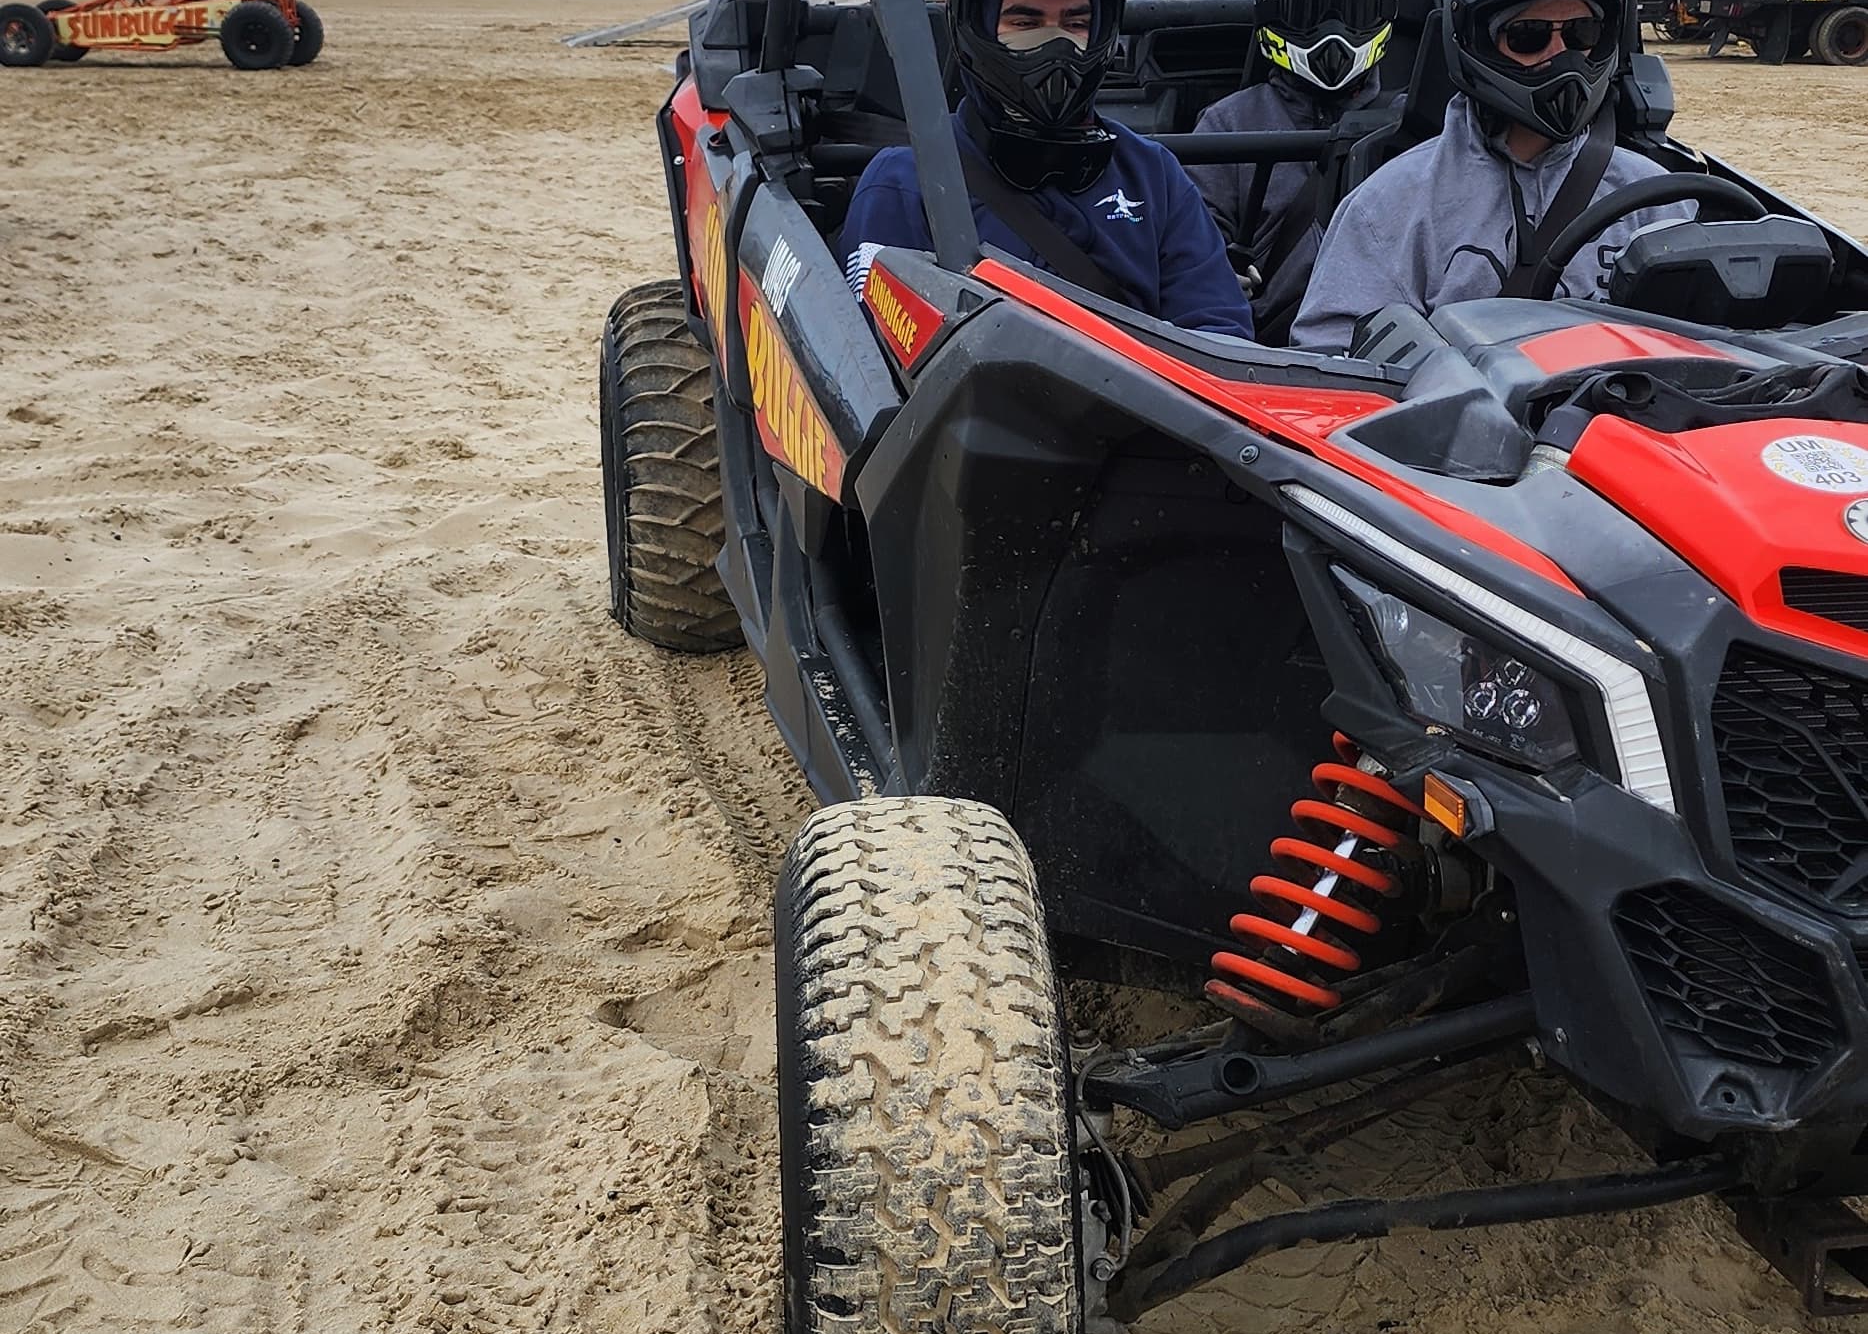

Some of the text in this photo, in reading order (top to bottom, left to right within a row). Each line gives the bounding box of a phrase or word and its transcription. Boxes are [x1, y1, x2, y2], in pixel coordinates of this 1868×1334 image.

[868, 268, 918, 355] SUNBUGGIE
[1774, 439, 1823, 453] UM
[1815, 471, 1862, 485] 403
